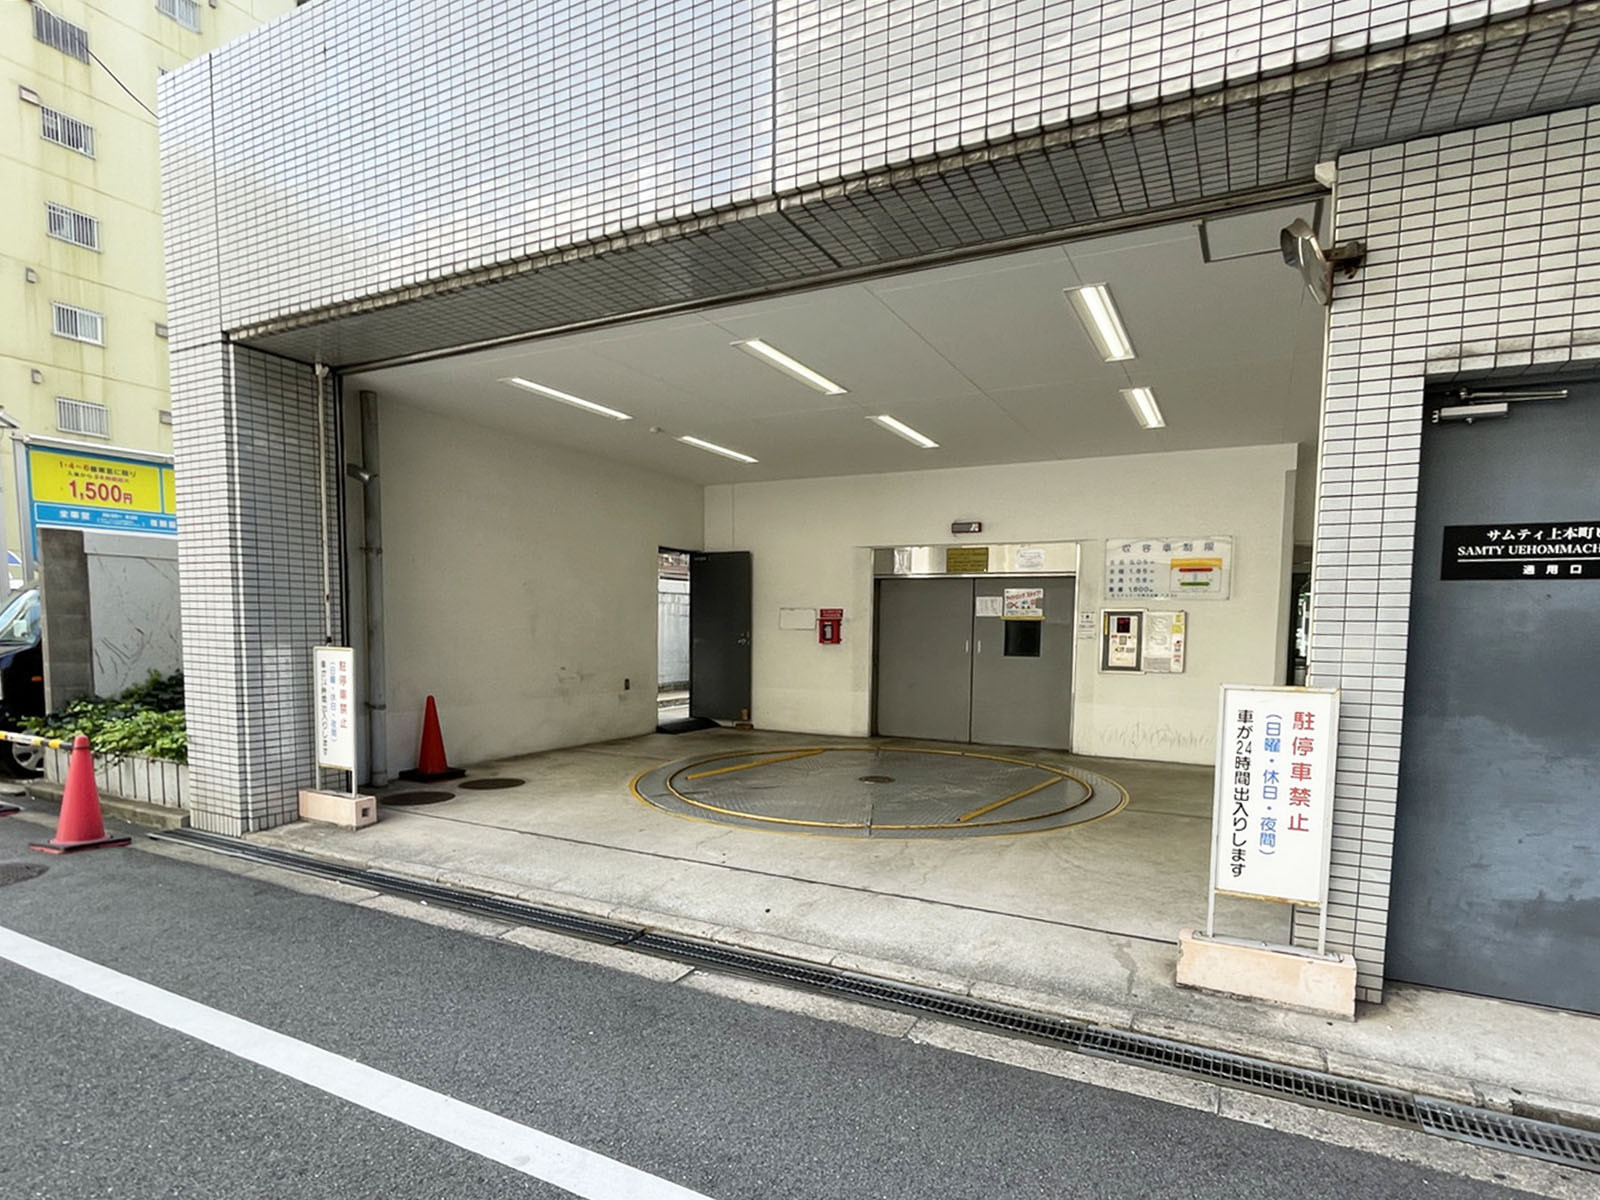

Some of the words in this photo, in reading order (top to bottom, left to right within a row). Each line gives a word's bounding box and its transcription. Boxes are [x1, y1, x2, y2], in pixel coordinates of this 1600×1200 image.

[69, 480, 133, 504] 1,500円
[1457, 545, 1504, 556] SAMTY
[1230, 709, 1255, 878] 車が24時間出入りします
[1287, 711, 1316, 833] 駐停車禁止
